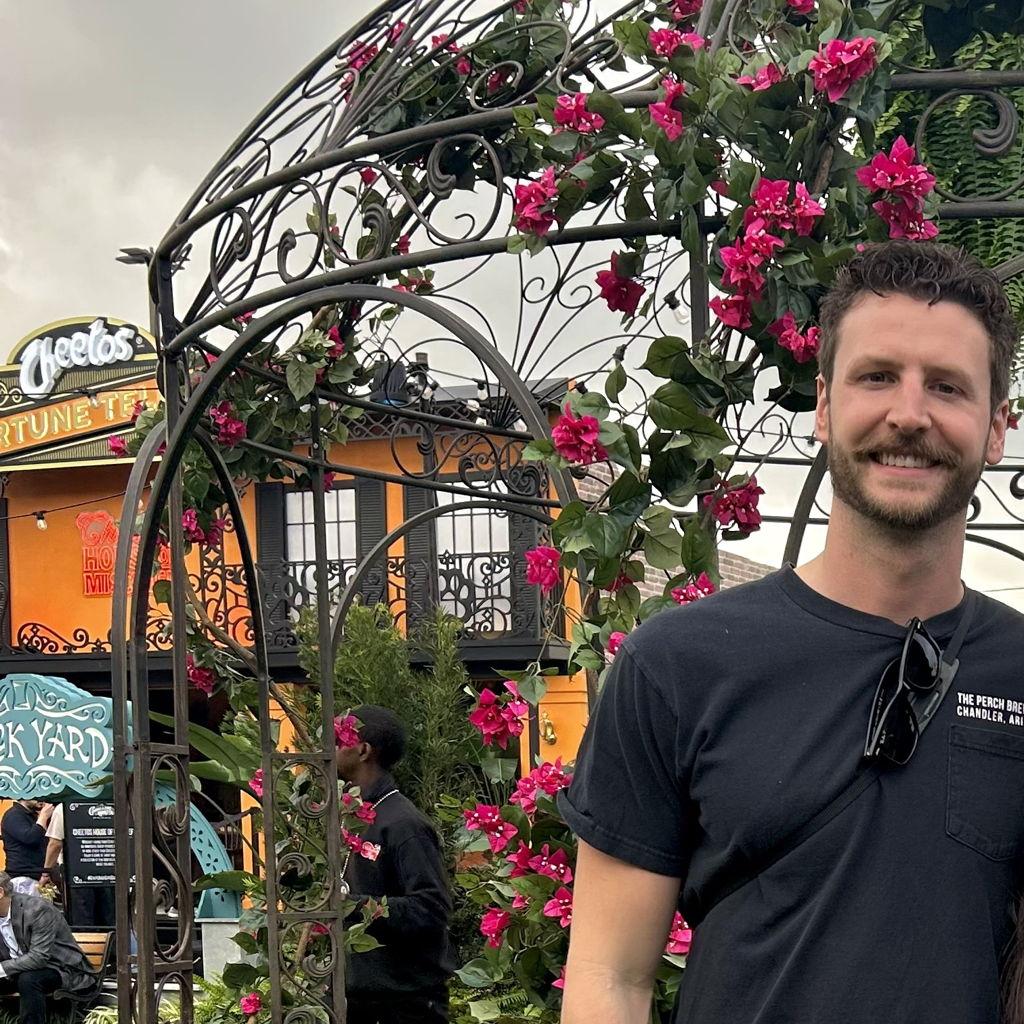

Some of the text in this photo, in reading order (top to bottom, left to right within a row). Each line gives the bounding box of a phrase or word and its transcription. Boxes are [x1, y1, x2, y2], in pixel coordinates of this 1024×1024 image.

[19, 318, 136, 399] Cheetos
[957, 692, 975, 705] THE
[976, 694, 1005, 710] PERCH
[957, 705, 1006, 724] CHANDLER,
[30, 719, 109, 768] YARD
